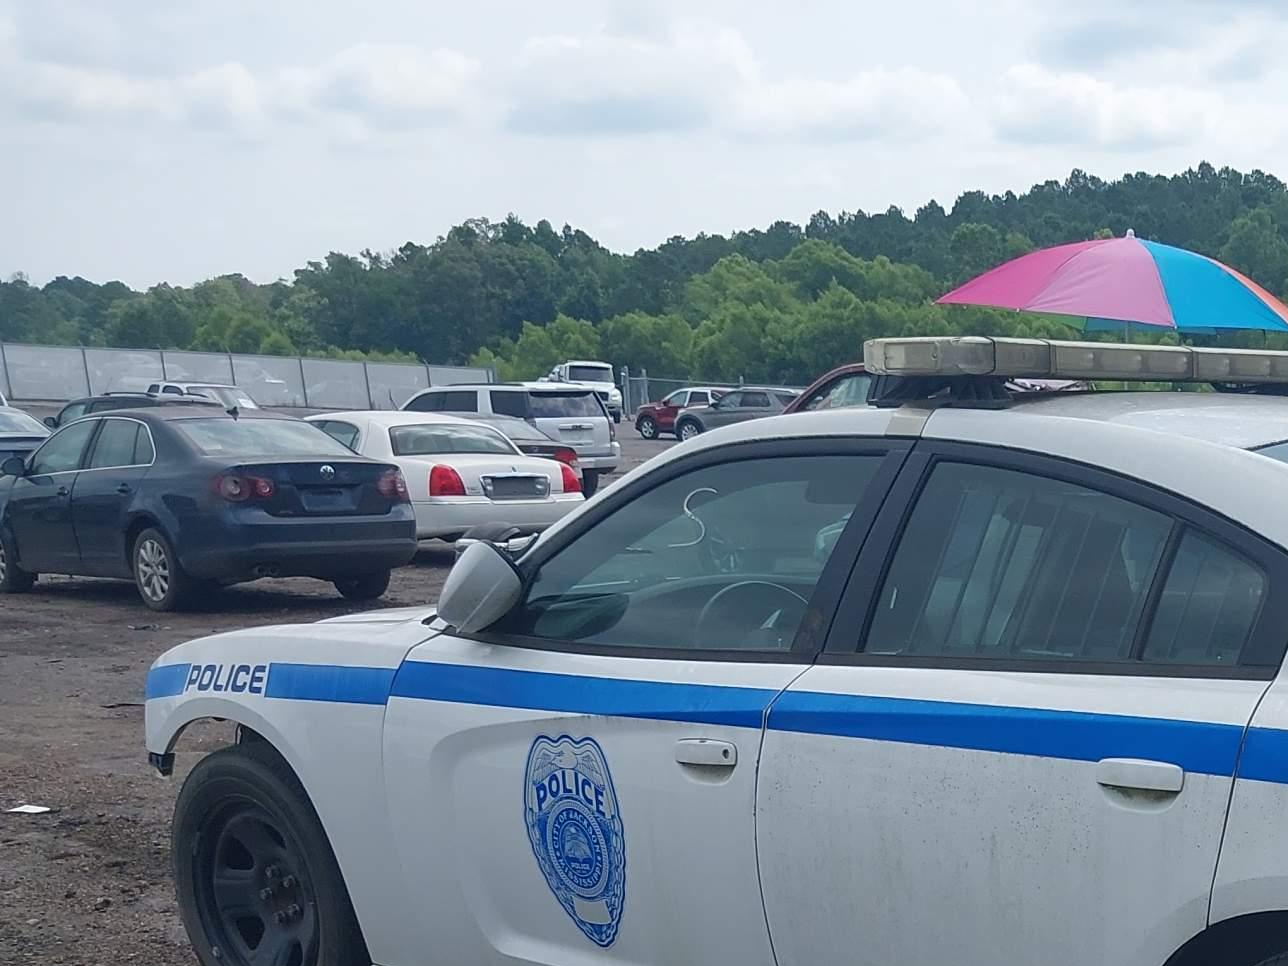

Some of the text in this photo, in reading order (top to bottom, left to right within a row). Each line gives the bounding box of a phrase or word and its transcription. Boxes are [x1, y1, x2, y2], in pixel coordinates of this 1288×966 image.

[185, 664, 267, 694] POLICE
[536, 770, 605, 818] POLICE
[569, 811, 602, 854] JACKSON
